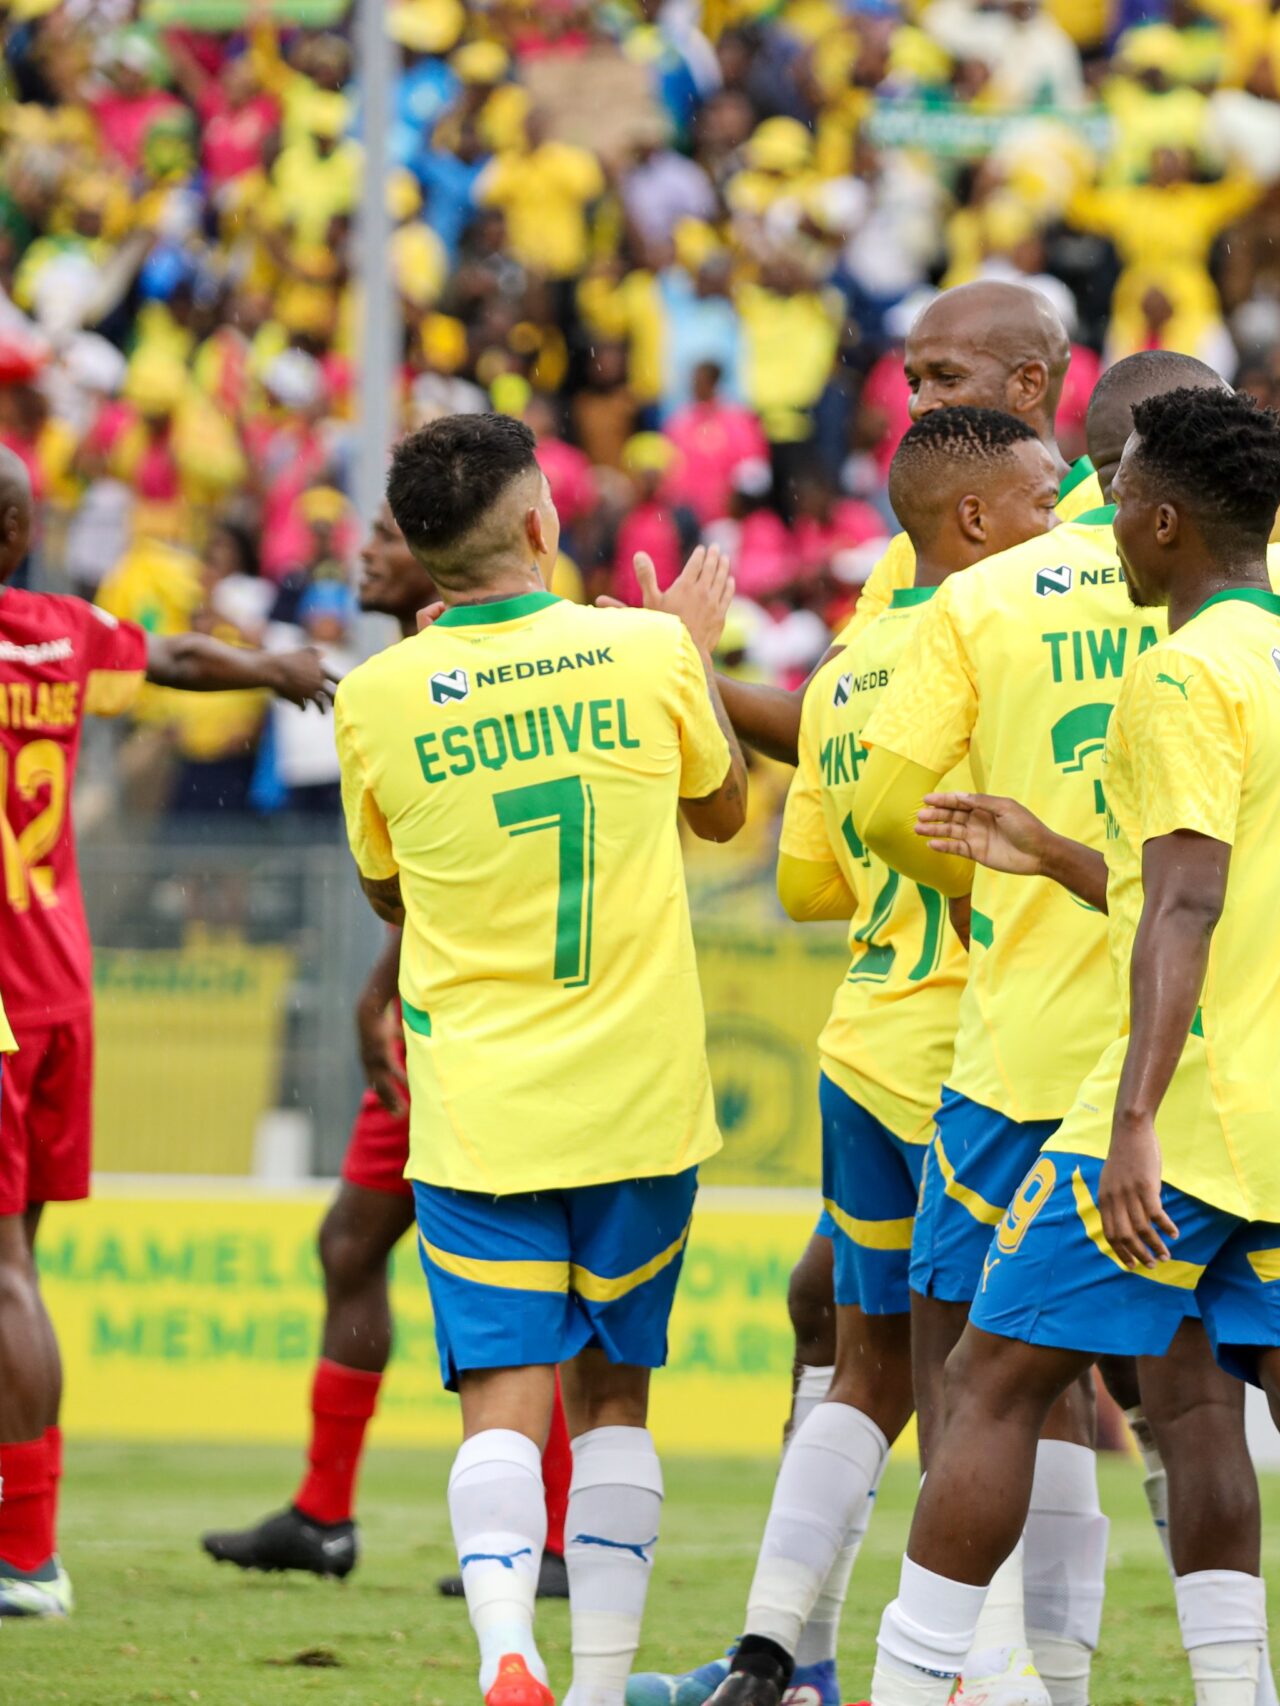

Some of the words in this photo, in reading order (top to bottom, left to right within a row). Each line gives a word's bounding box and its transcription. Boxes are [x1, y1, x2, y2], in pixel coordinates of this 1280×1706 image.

[475, 647, 615, 688] NEDBANK
[414, 698, 640, 784] ESQUIVEL
[492, 774, 596, 989] 7
